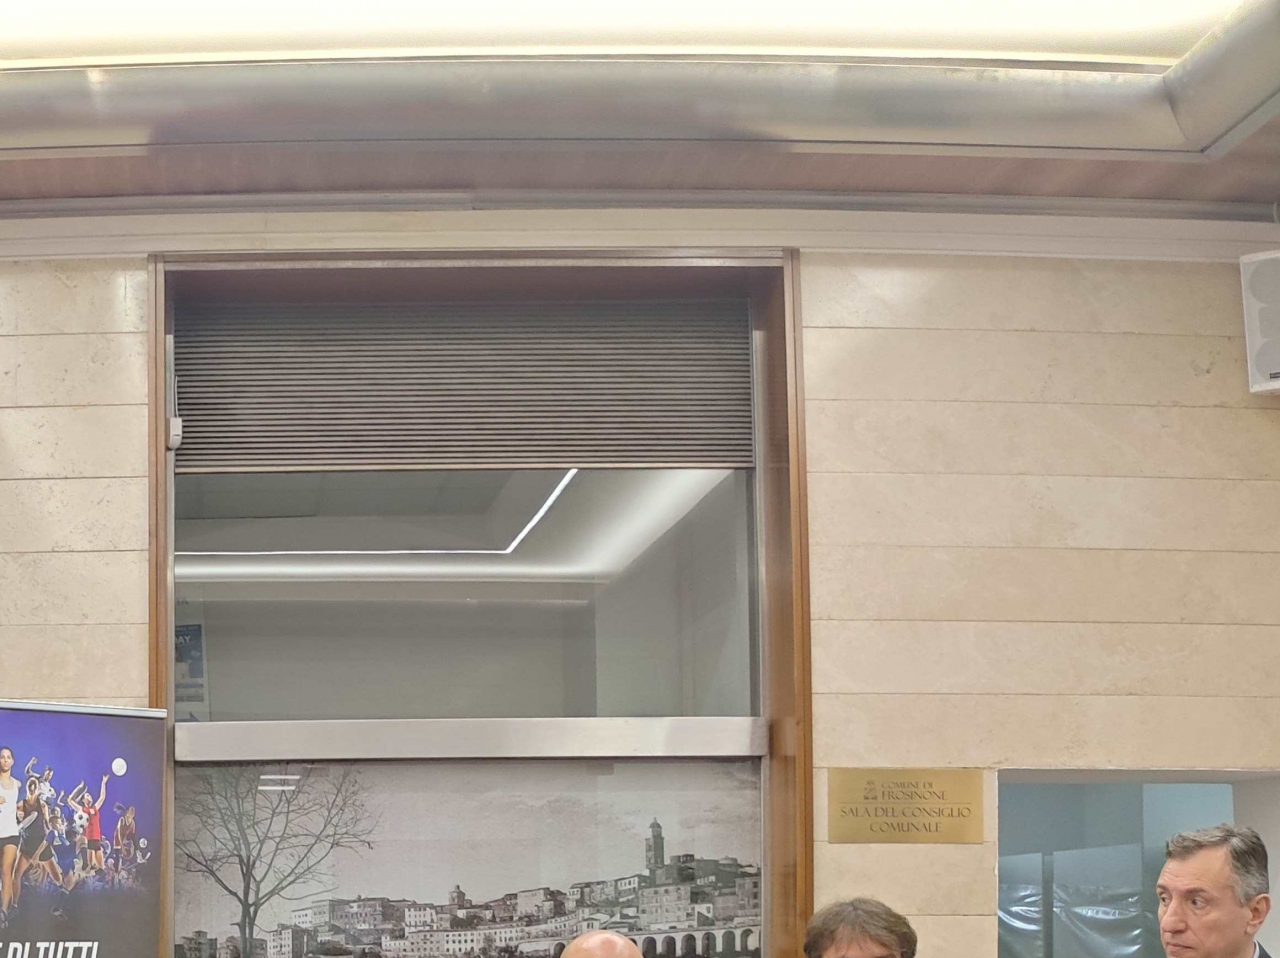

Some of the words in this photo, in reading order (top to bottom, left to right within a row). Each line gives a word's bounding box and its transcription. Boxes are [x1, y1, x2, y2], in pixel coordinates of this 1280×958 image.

[923, 781, 933, 789] DI
[881, 790, 946, 801] FROSINONE
[840, 807, 871, 818] SALA
[874, 807, 898, 818] DEL
[902, 806, 972, 818] CONSIGLIO
[870, 822, 942, 833] COMUNALE
